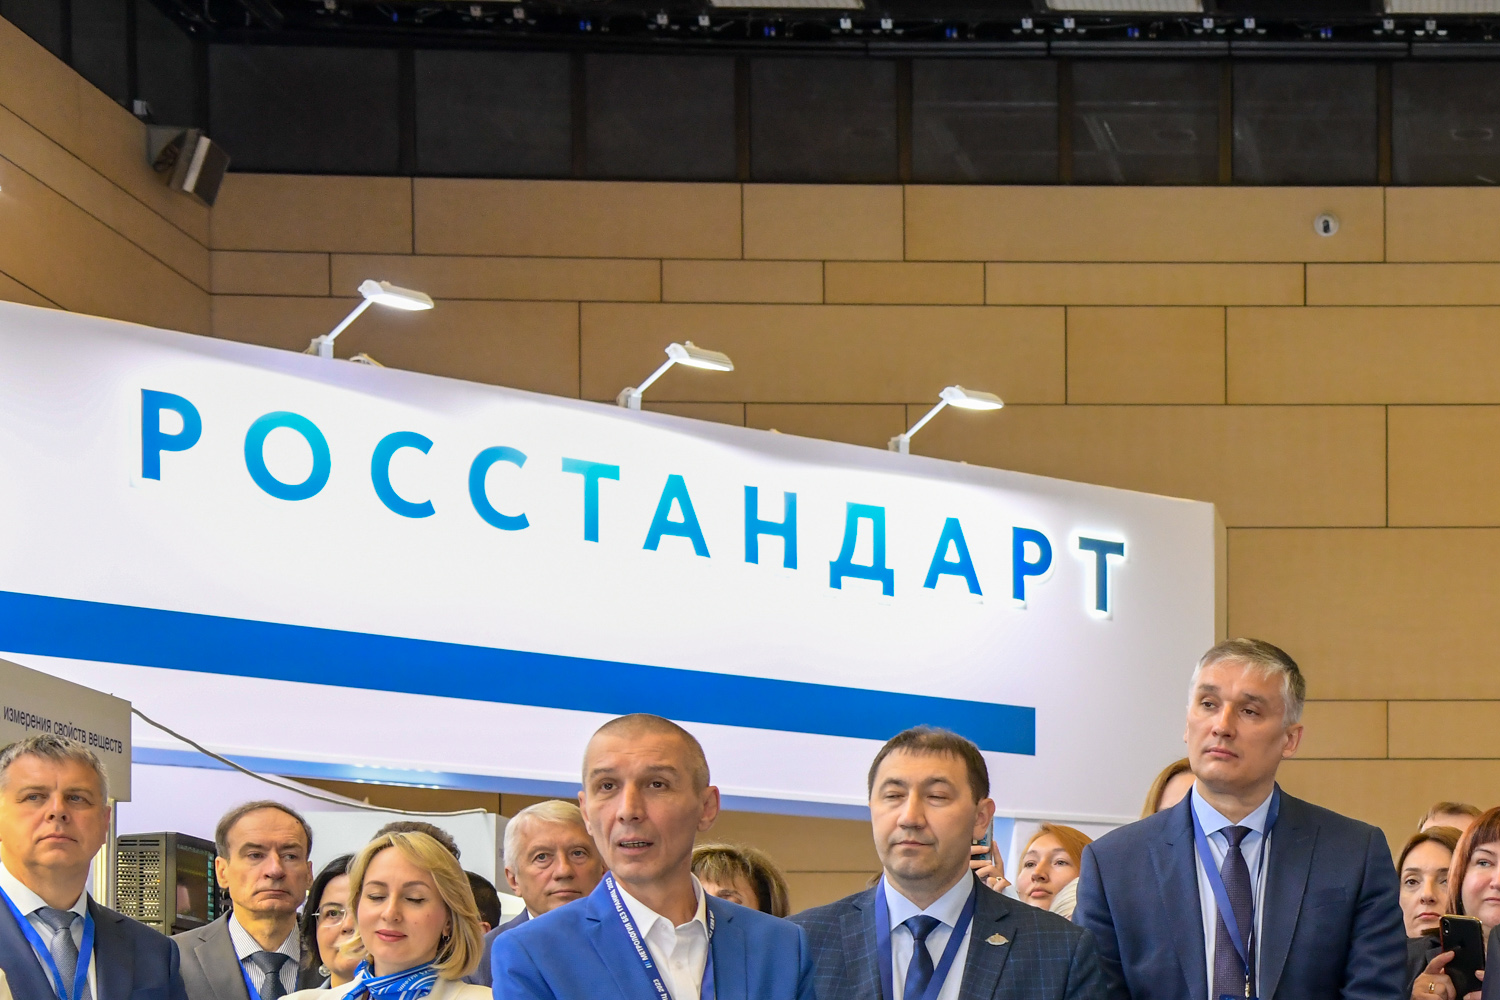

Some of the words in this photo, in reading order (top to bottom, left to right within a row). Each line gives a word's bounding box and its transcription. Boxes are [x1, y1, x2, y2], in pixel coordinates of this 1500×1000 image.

[140, 387, 1127, 614] РОССТАНДАРТ
[3, 706, 52, 732] измерения
[53, 721, 87, 744] свойств
[88, 731, 123, 754] веществ
[652, 978, 665, 993] 2023
